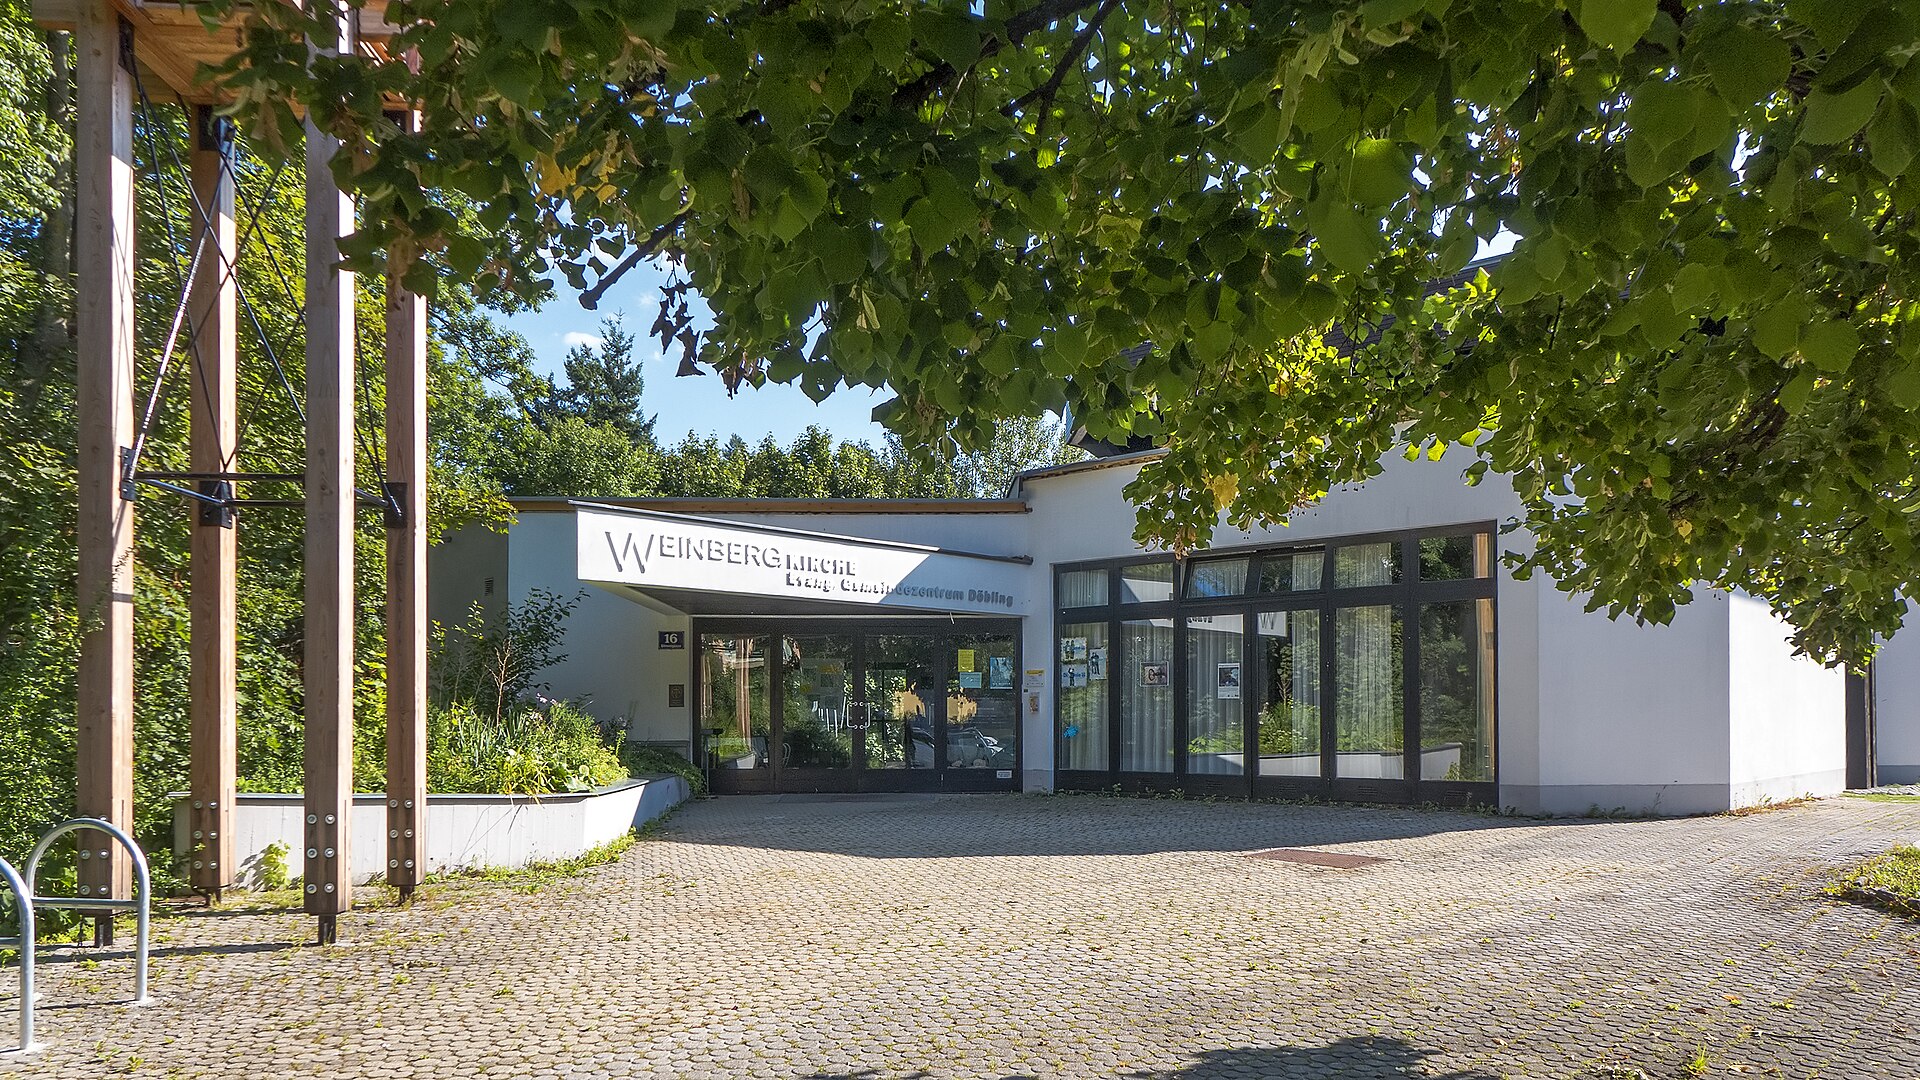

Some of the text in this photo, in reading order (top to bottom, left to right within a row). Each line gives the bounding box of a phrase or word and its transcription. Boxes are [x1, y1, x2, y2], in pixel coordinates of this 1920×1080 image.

[604, 531, 782, 574] WEINBERG
[785, 554, 856, 577] KIRCHE
[839, 578, 965, 601] Gemeindezentrum
[967, 588, 1014, 608] Döbling
[663, 633, 678, 644] 16
